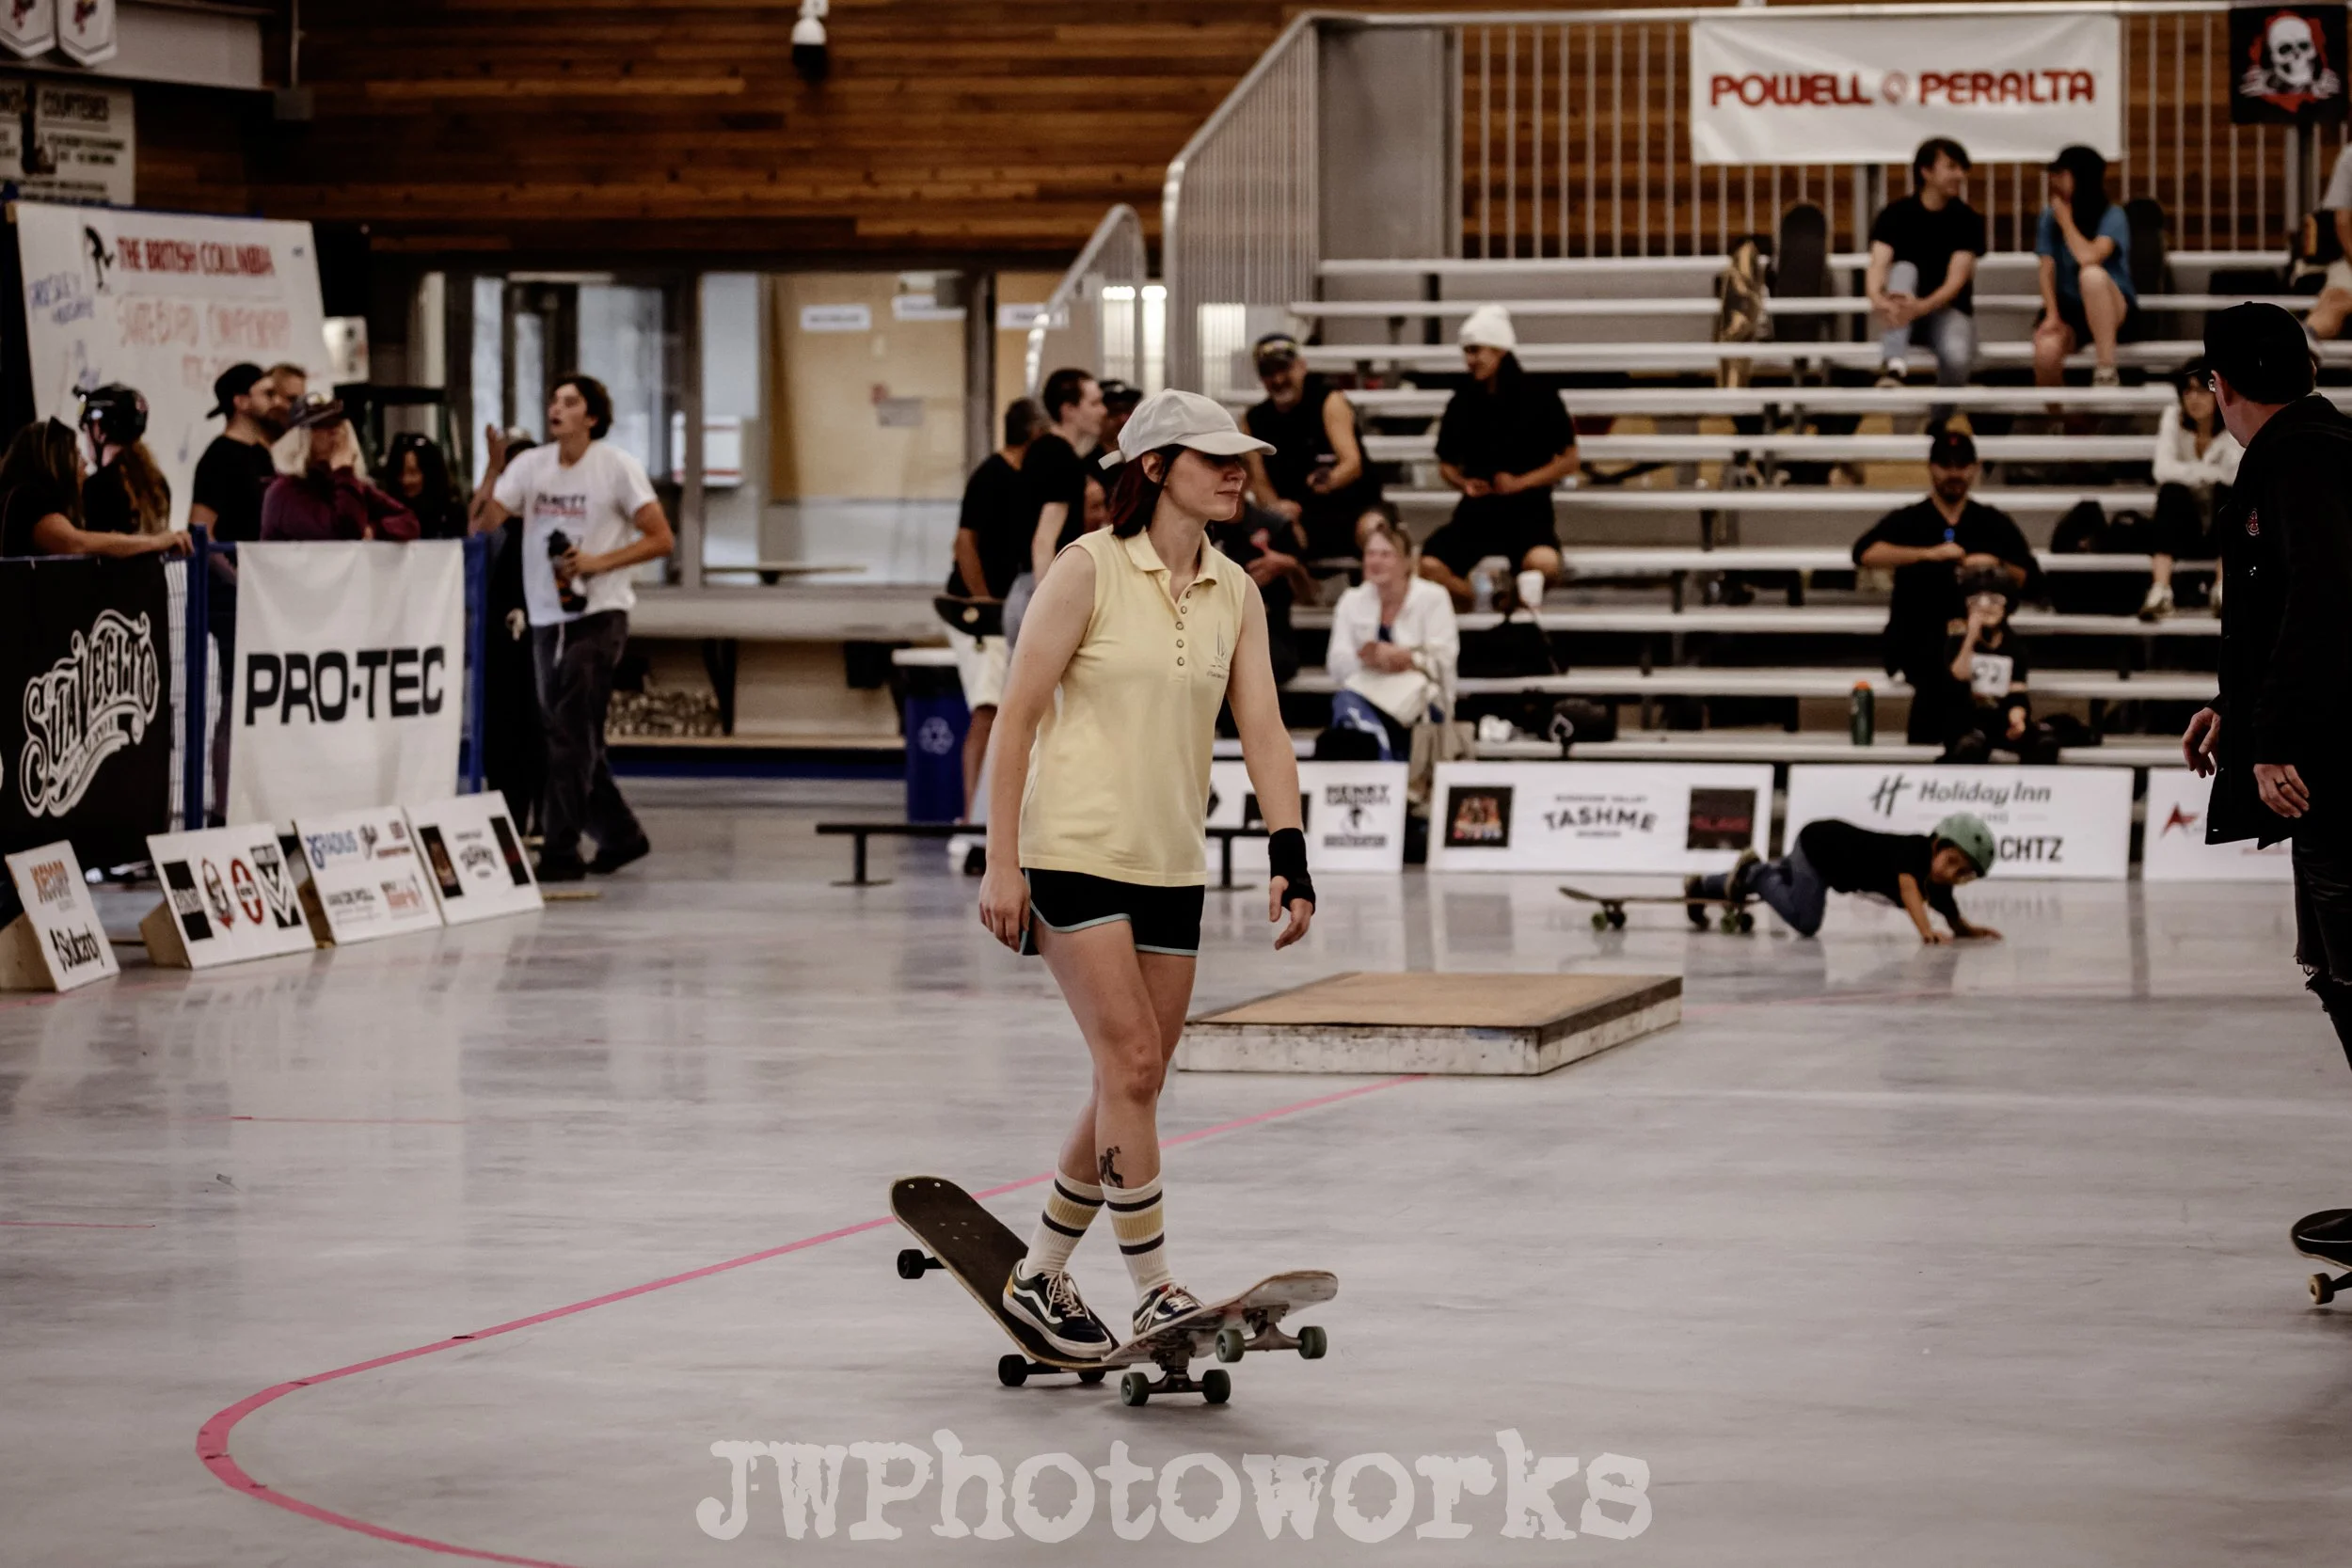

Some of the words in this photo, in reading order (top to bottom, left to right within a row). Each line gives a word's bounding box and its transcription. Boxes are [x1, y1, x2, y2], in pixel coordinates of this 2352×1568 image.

[1710, 74, 1873, 107] POWELL
[1920, 70, 2096, 105] PERALTA
[1918, 780, 2010, 806] Holiday
[2013, 780, 2052, 801] Inn
[1543, 805, 1659, 833] TASHME
[1999, 835, 2064, 863] CHTZ
